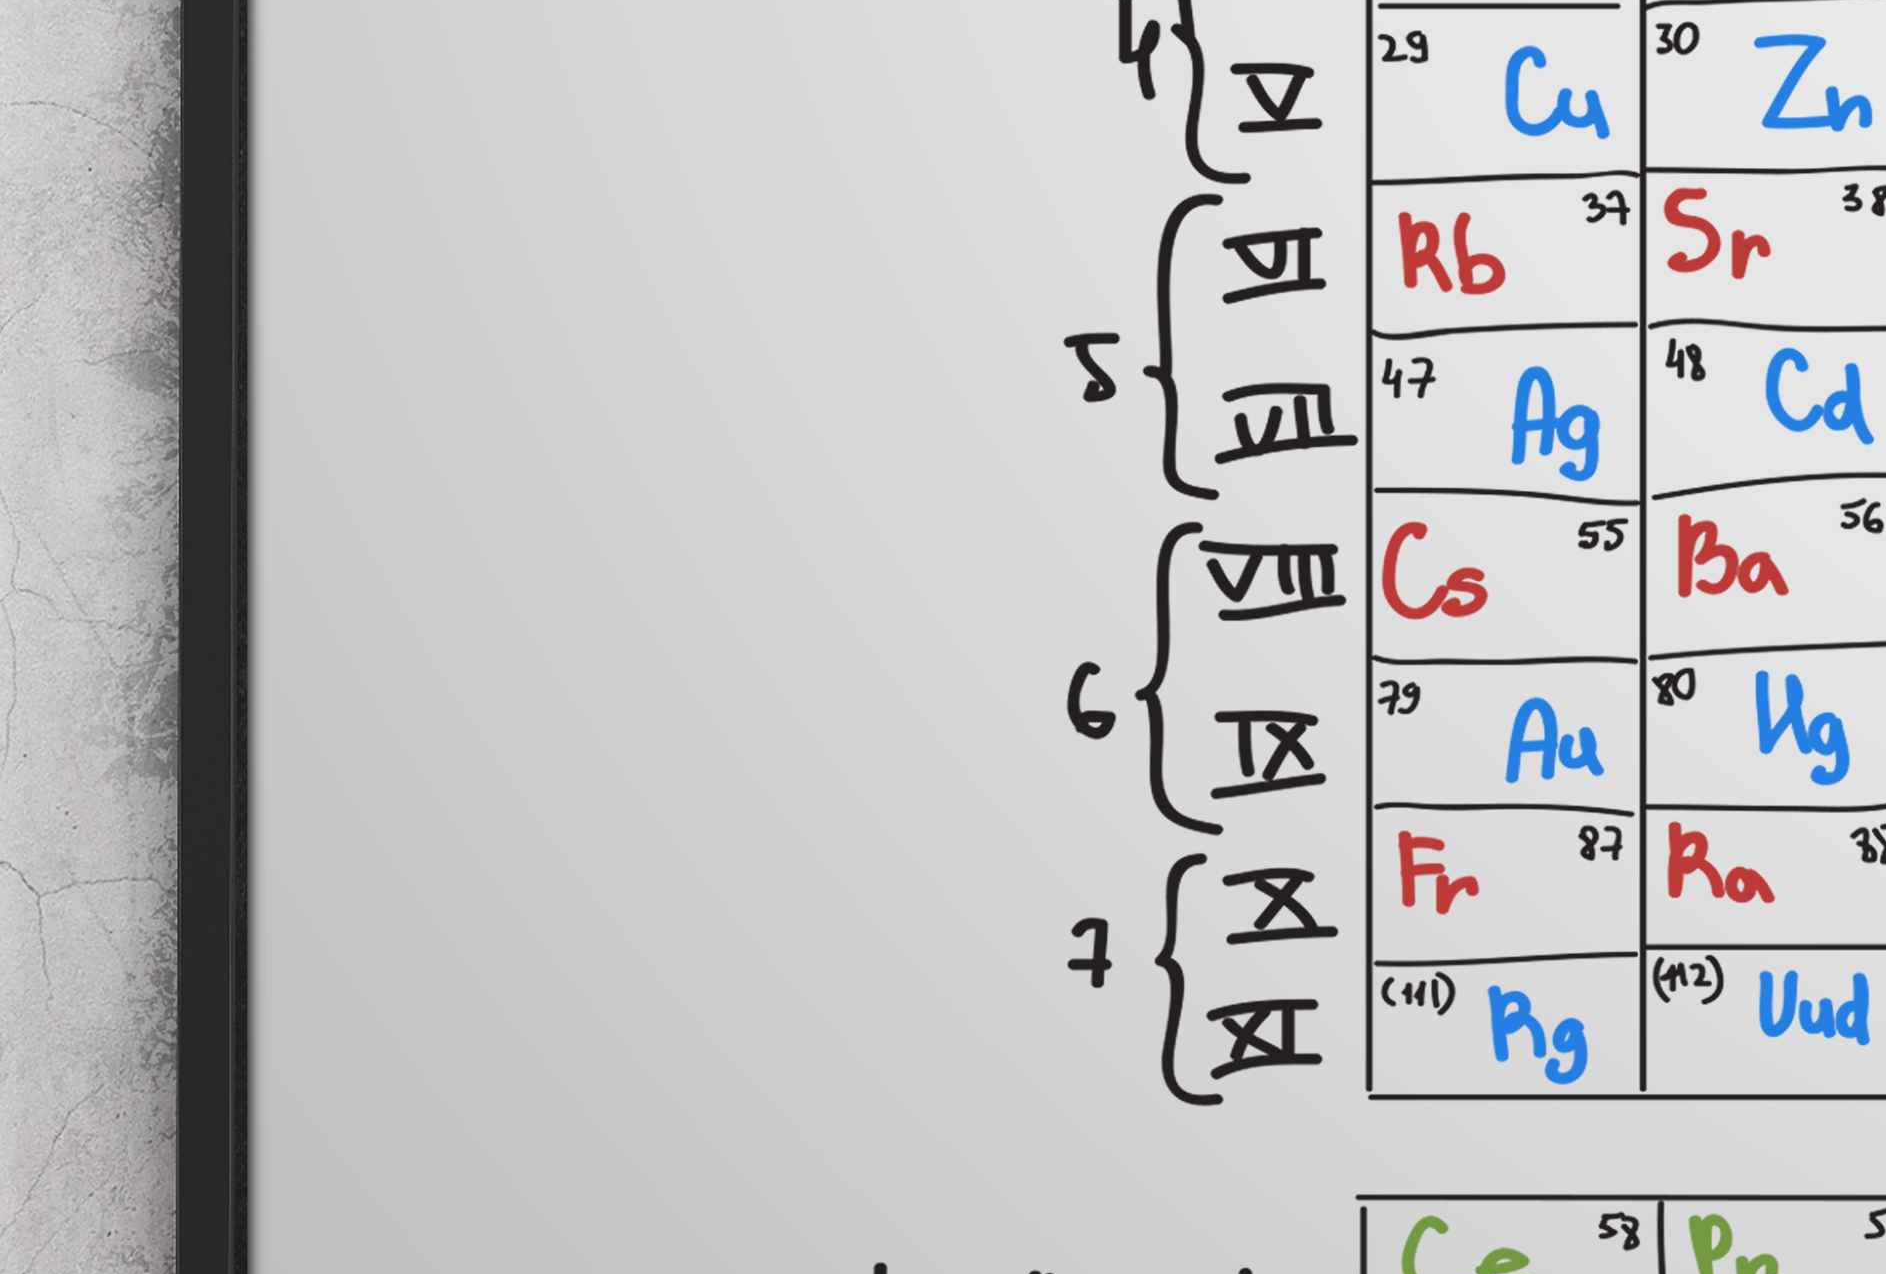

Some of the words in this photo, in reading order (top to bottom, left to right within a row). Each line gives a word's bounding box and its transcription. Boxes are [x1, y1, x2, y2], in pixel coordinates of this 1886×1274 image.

[1230, 62, 1323, 133] V
[1377, 30, 1429, 64] 29
[1504, 45, 1611, 140] Cu
[1655, 21, 1700, 55] 30
[1753, 33, 1873, 133] Zn
[1222, 227, 1327, 305] VI
[1398, 212, 1506, 295] Rb
[1582, 189, 1631, 226] 37
[1663, 188, 1771, 280] Sr
[1063, 332, 1120, 403] 5
[1765, 347, 1875, 446] Cd
[1214, 382, 1359, 465] VII
[1381, 357, 1436, 399] 47
[1511, 366, 1601, 482] Ag
[1198, 540, 1347, 621] VIII
[1382, 521, 1489, 620] Cs
[1578, 518, 1629, 552] 55
[1678, 513, 1789, 598] Ba
[1842, 499, 1885, 535] 56
[1067, 661, 1116, 740] 6
[1651, 667, 1696, 707] 80
[1210, 710, 1327, 800] IX
[1377, 679, 1421, 716] 79
[1504, 696, 1605, 784] Au
[1398, 830, 1479, 915] Fr
[1578, 825, 1623, 861] 87
[1667, 821, 1776, 904] Ra
[1222, 867, 1339, 945] X
[1067, 917, 1113, 989] 7
[1206, 998, 1323, 1080] XI
[1487, 984, 1589, 1086] Rg
[1598, 1211, 1641, 1251] 58
